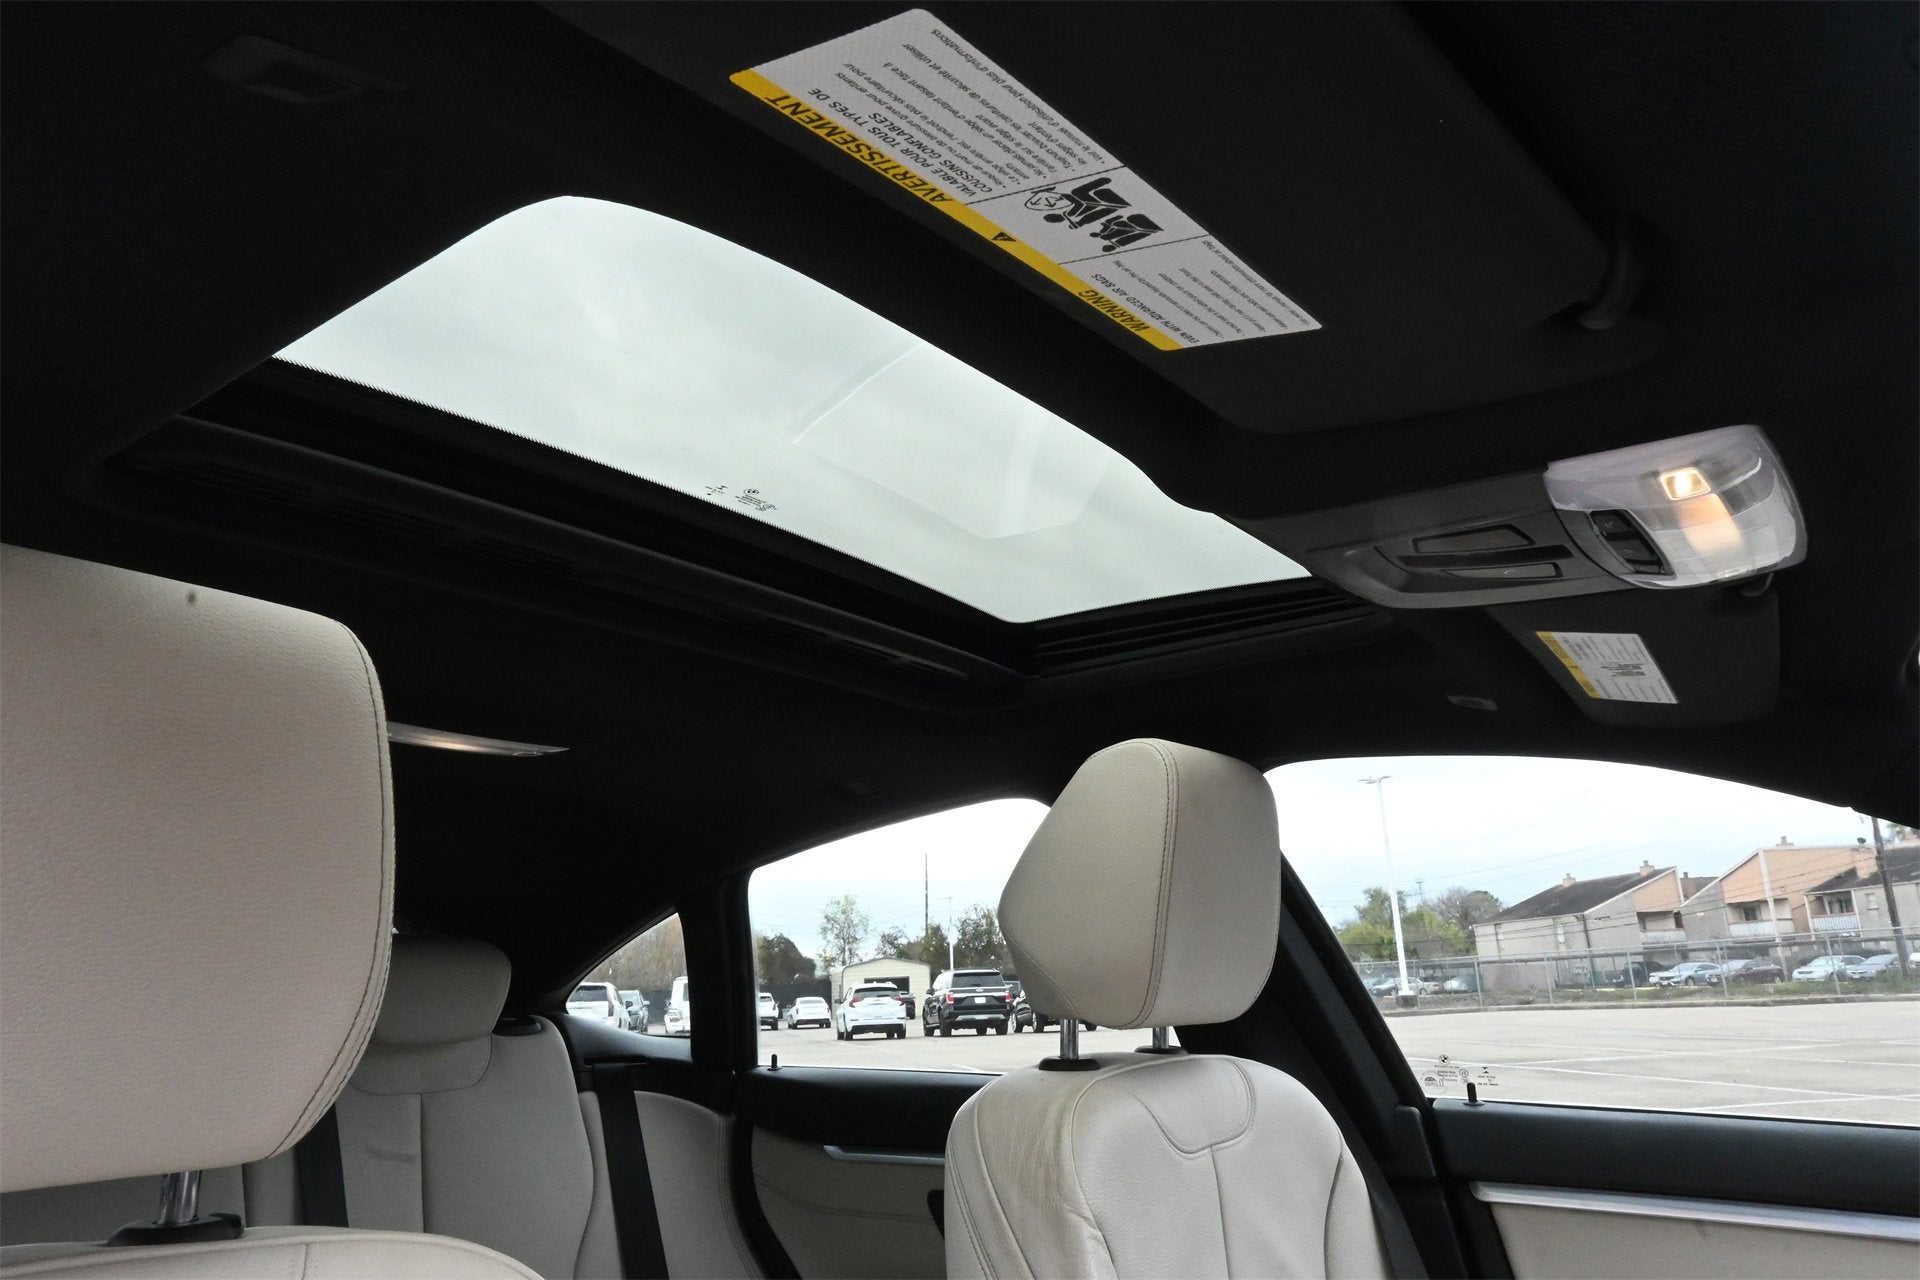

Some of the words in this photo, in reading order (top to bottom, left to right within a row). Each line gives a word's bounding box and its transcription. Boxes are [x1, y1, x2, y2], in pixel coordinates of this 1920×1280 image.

[805, 87, 833, 101] DE
[825, 100, 872, 127] TYPES
[763, 90, 954, 205] AVERTISSEMENT
[865, 111, 944, 160] GONFLABLES
[865, 125, 904, 148] TOUS
[897, 147, 935, 168] POUR
[928, 167, 979, 197] VALABLE
[936, 158, 994, 193] COUSSINS
[1087, 273, 1117, 288] BAGS
[1109, 287, 1130, 296] AIR
[1073, 289, 1153, 331] WARNING
[1122, 296, 1167, 321] ADVANCED
[1159, 320, 1184, 332] WITH
